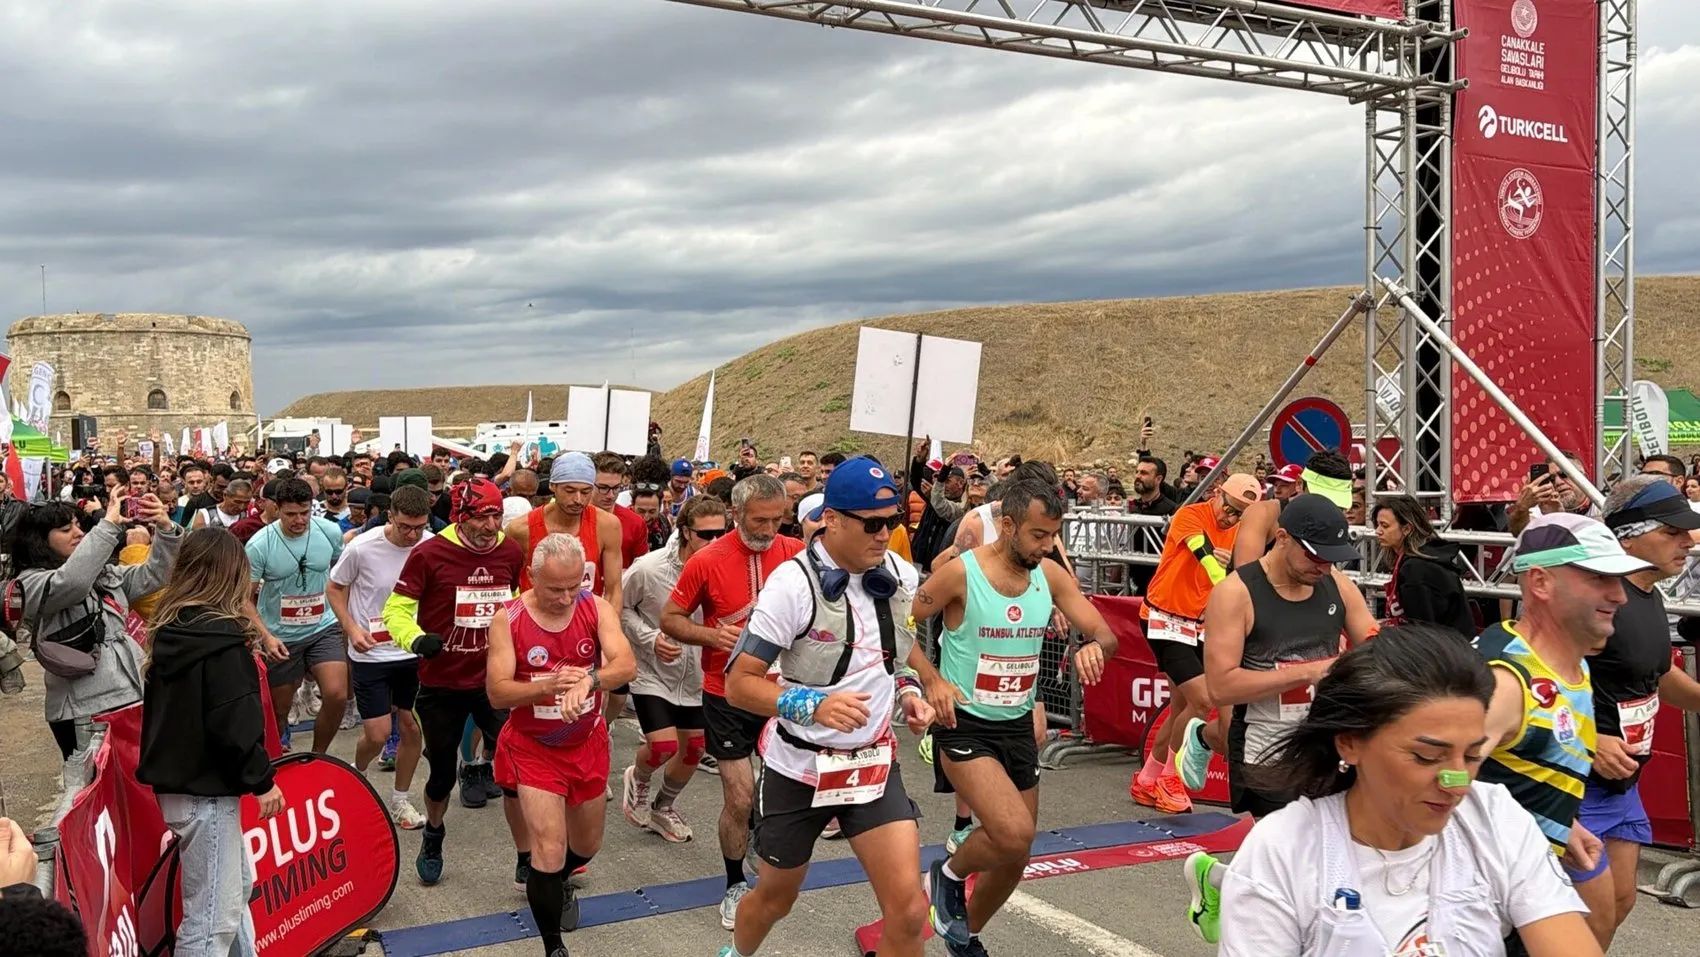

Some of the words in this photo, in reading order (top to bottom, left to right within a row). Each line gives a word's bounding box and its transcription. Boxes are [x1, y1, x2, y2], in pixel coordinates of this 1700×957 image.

[1498, 115, 1568, 143] TURKCELL
[295, 607, 313, 617] 42
[474, 603, 496, 617] 53
[997, 677, 1022, 692] 54
[845, 769, 861, 787] 4
[243, 788, 341, 885] PLUS
